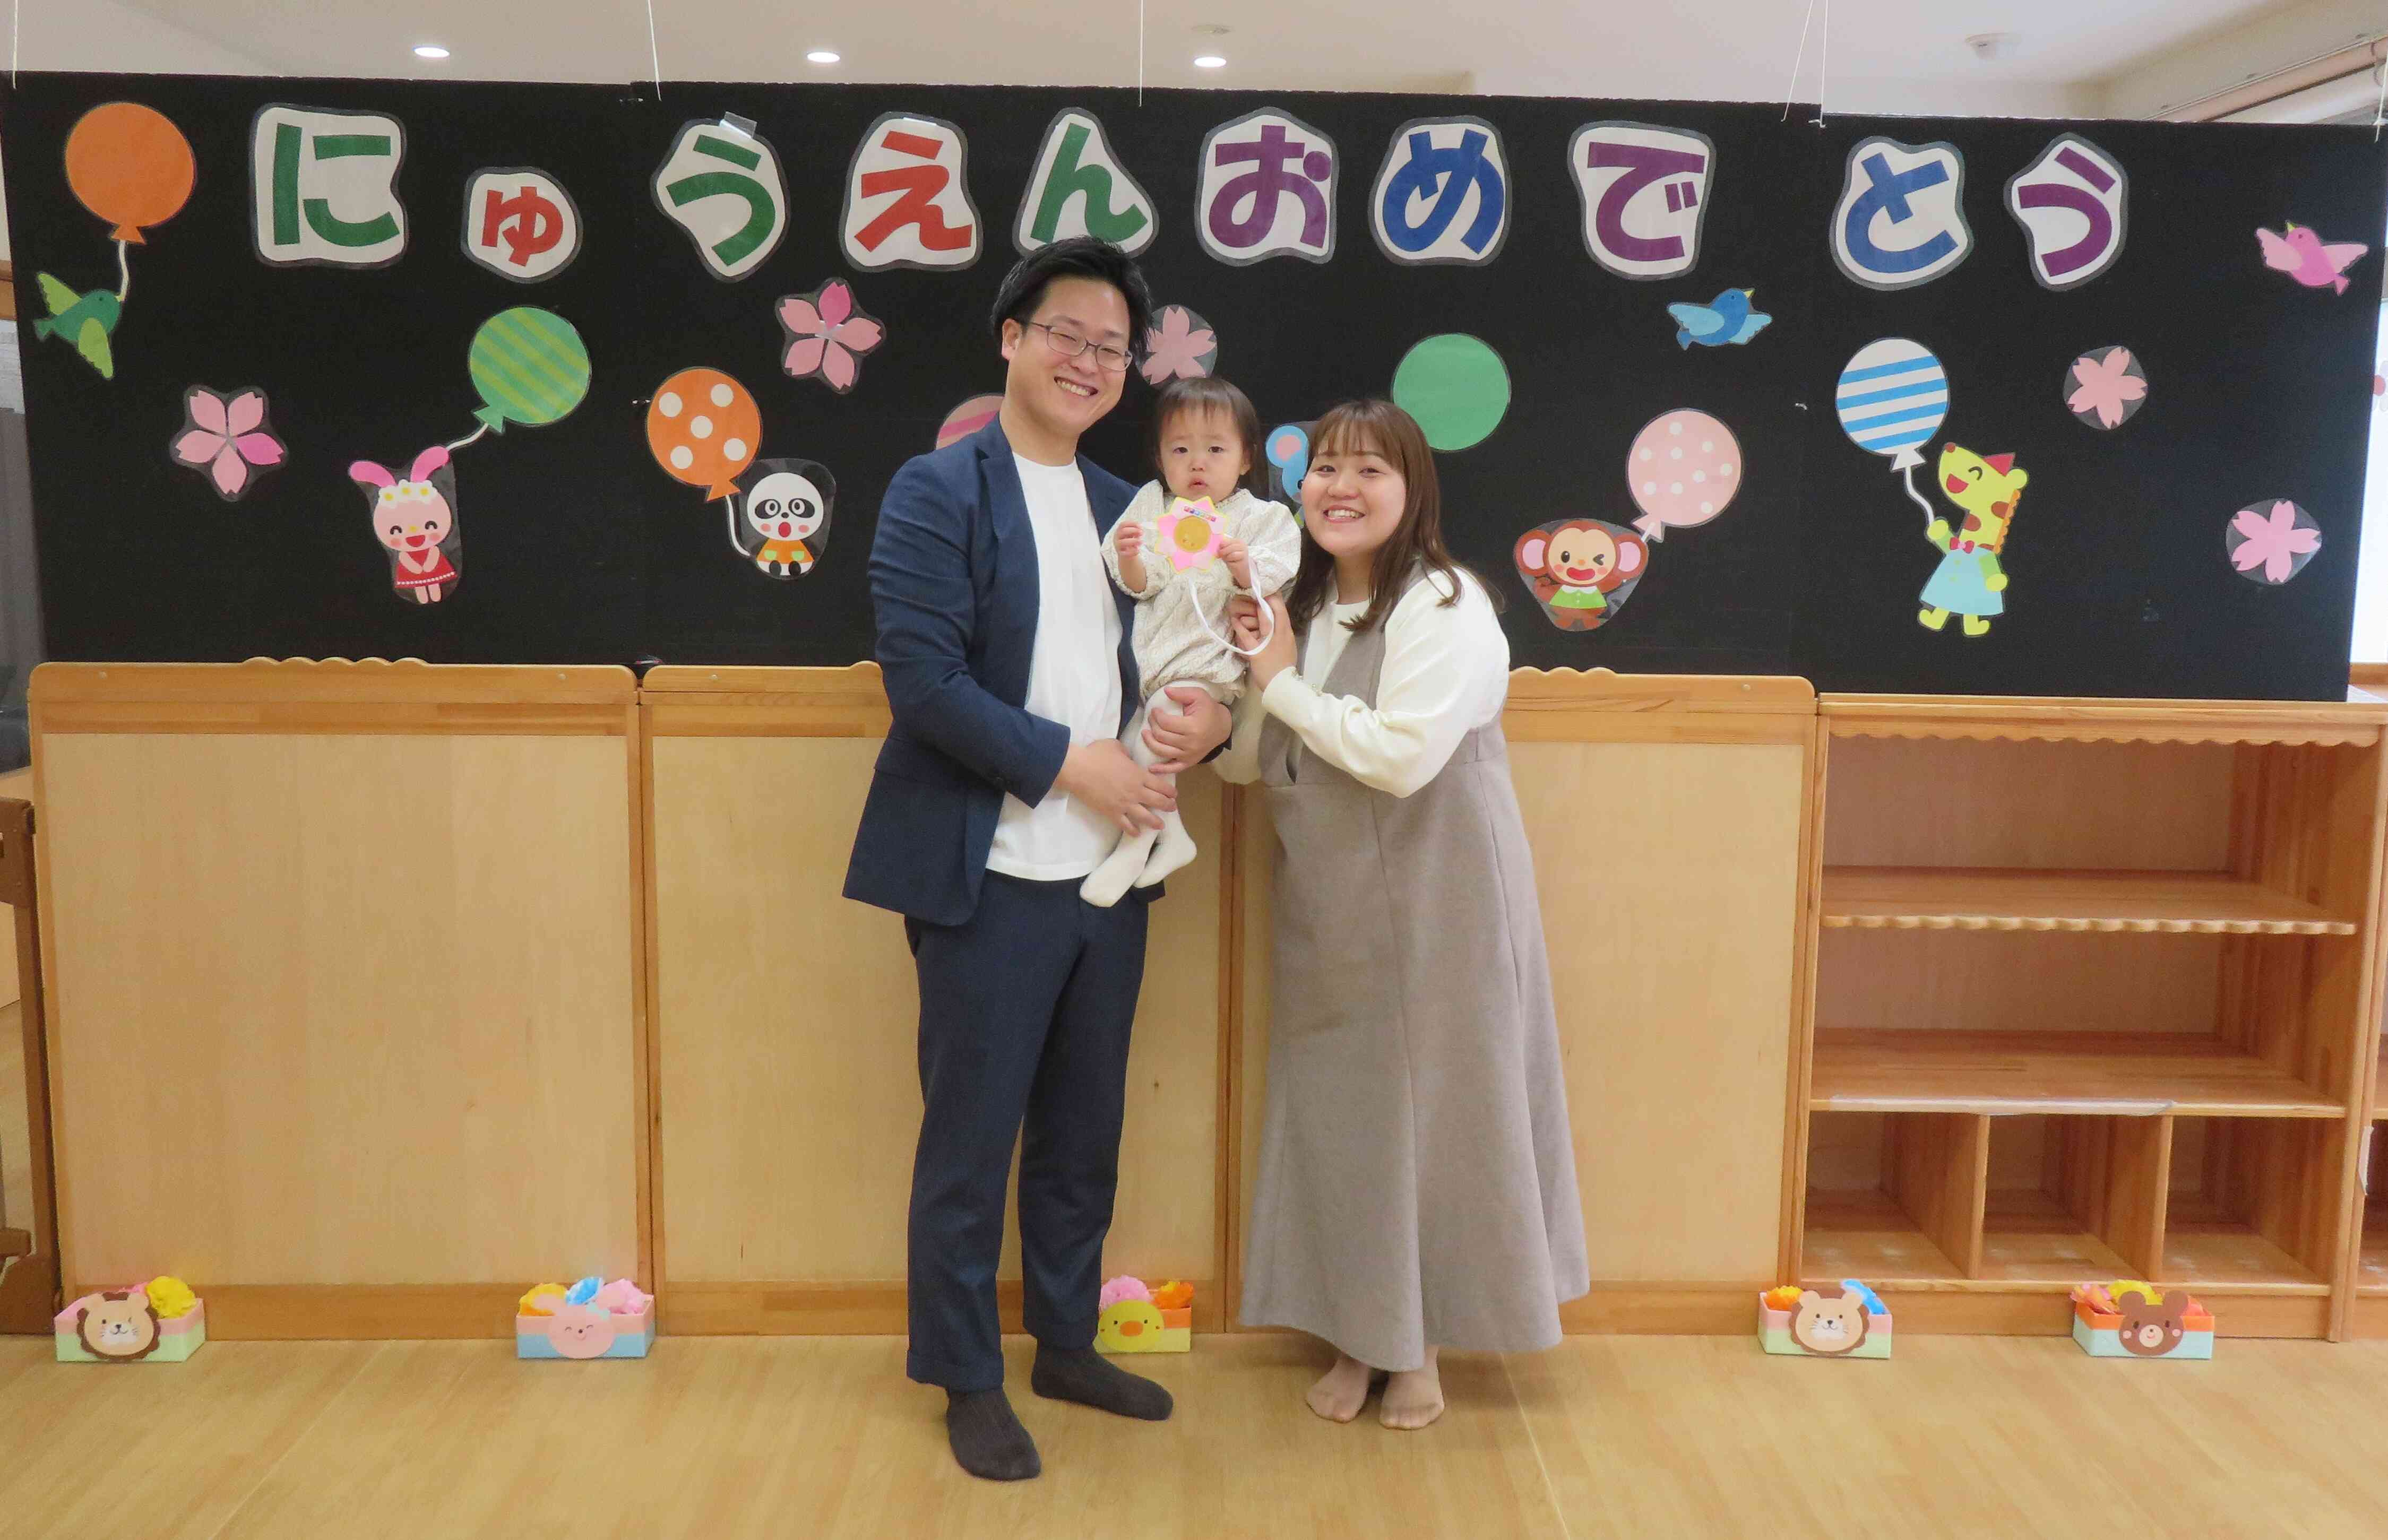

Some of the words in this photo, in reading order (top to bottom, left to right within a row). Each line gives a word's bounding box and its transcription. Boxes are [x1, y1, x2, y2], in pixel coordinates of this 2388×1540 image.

[273, 122, 2116, 277] にゅうえんおめでとう
